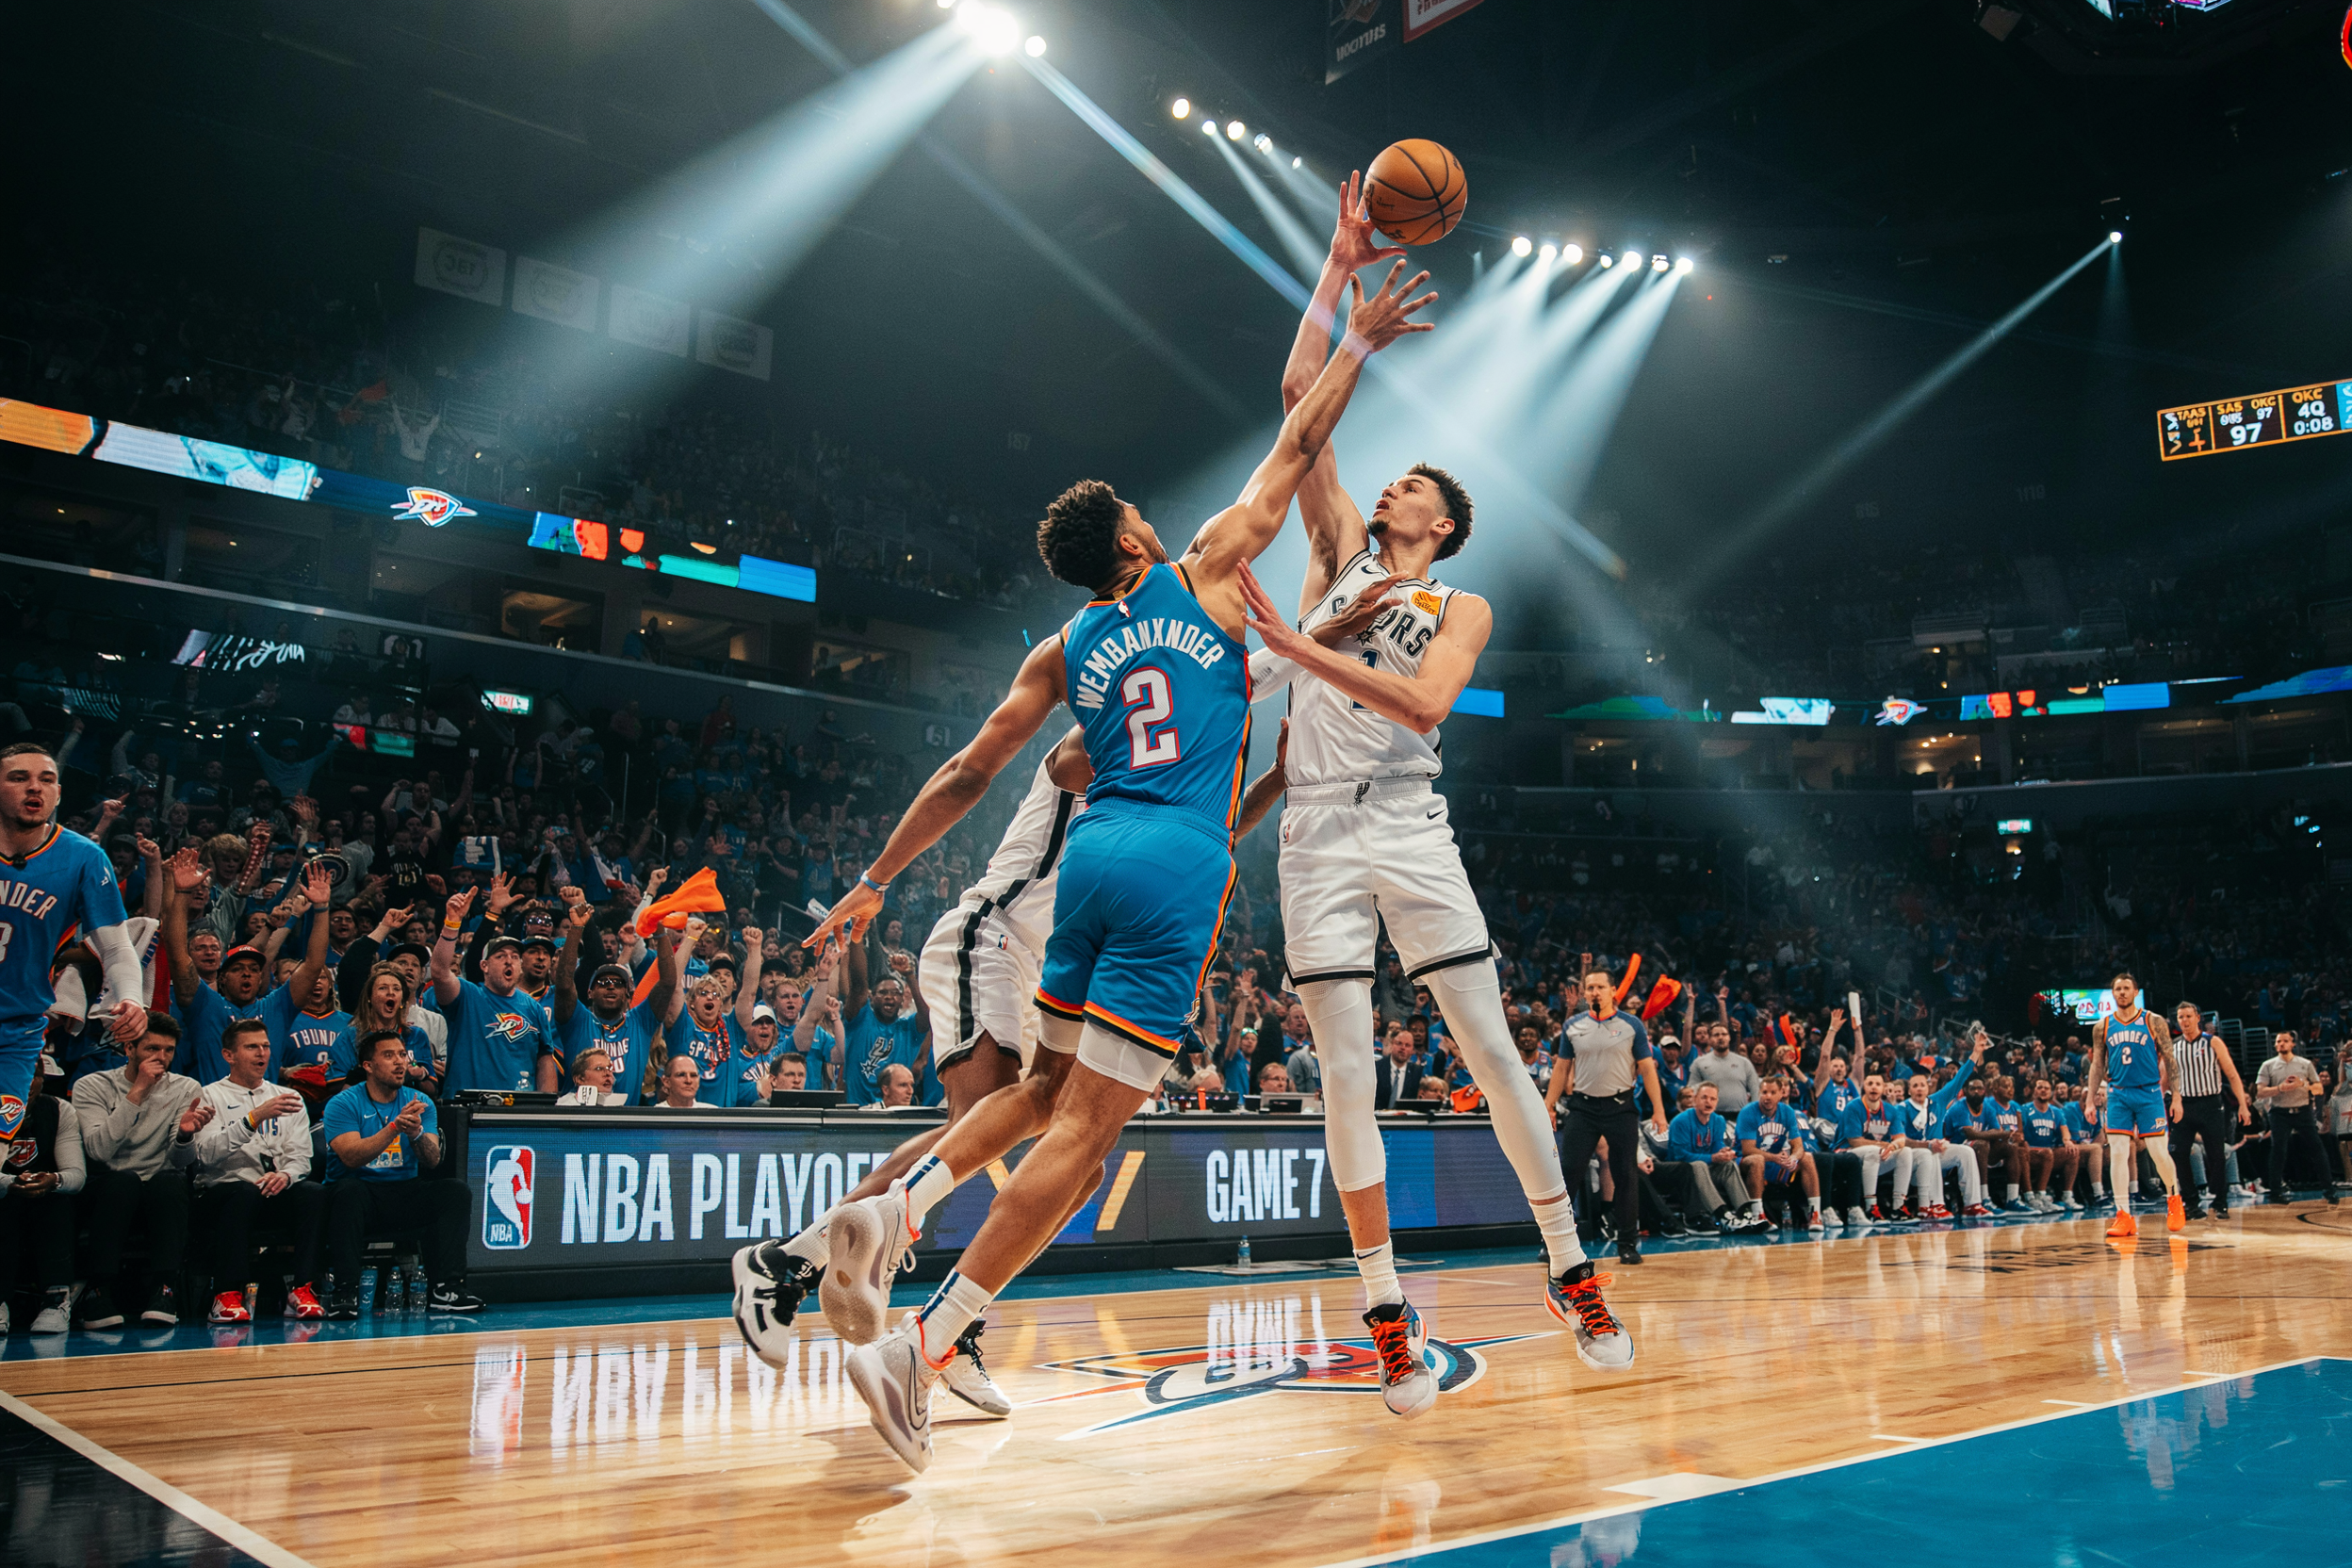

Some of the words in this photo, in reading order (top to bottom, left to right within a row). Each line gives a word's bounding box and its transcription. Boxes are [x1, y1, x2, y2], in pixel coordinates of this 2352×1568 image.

[2216, 400, 2244, 415] SAS
[2257, 406, 2273, 420] 97
[2297, 400, 2326, 418] 4Q
[2230, 421, 2262, 446] 97
[2294, 416, 2334, 435] 0:08
[1120, 666, 1181, 771] 2
[289, 1028, 342, 1049] THUND
[1207, 1148, 1300, 1223] GAME
[1305, 1148, 1326, 1218] 7
[562, 1152, 675, 1244] NBA
[690, 1152, 893, 1240] PLAYOF
[490, 1223, 513, 1242] NBA
